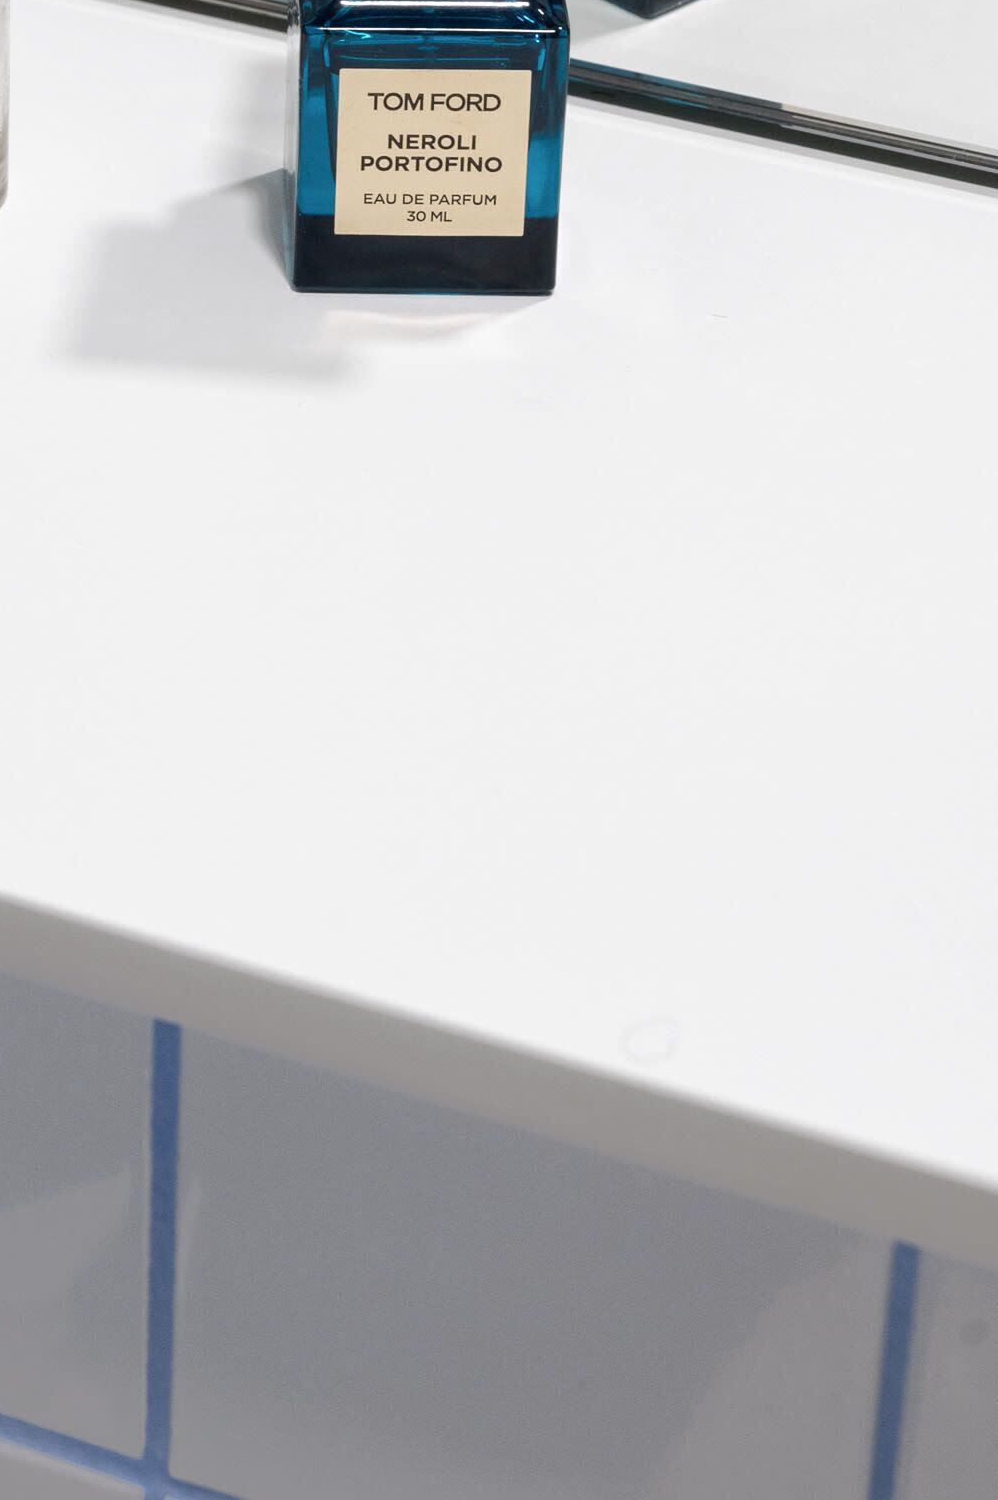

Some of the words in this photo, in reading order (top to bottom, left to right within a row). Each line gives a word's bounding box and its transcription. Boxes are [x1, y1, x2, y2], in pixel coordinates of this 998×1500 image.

[367, 92, 424, 111] TOM
[430, 93, 502, 112] FORD
[387, 134, 477, 150] NEROLI
[360, 155, 503, 173] PORTOFINO
[363, 193, 397, 205] EAU
[402, 194, 425, 205] DE
[429, 194, 498, 206] PARFUM
[406, 211, 426, 222] 30
[430, 211, 453, 223] ML
